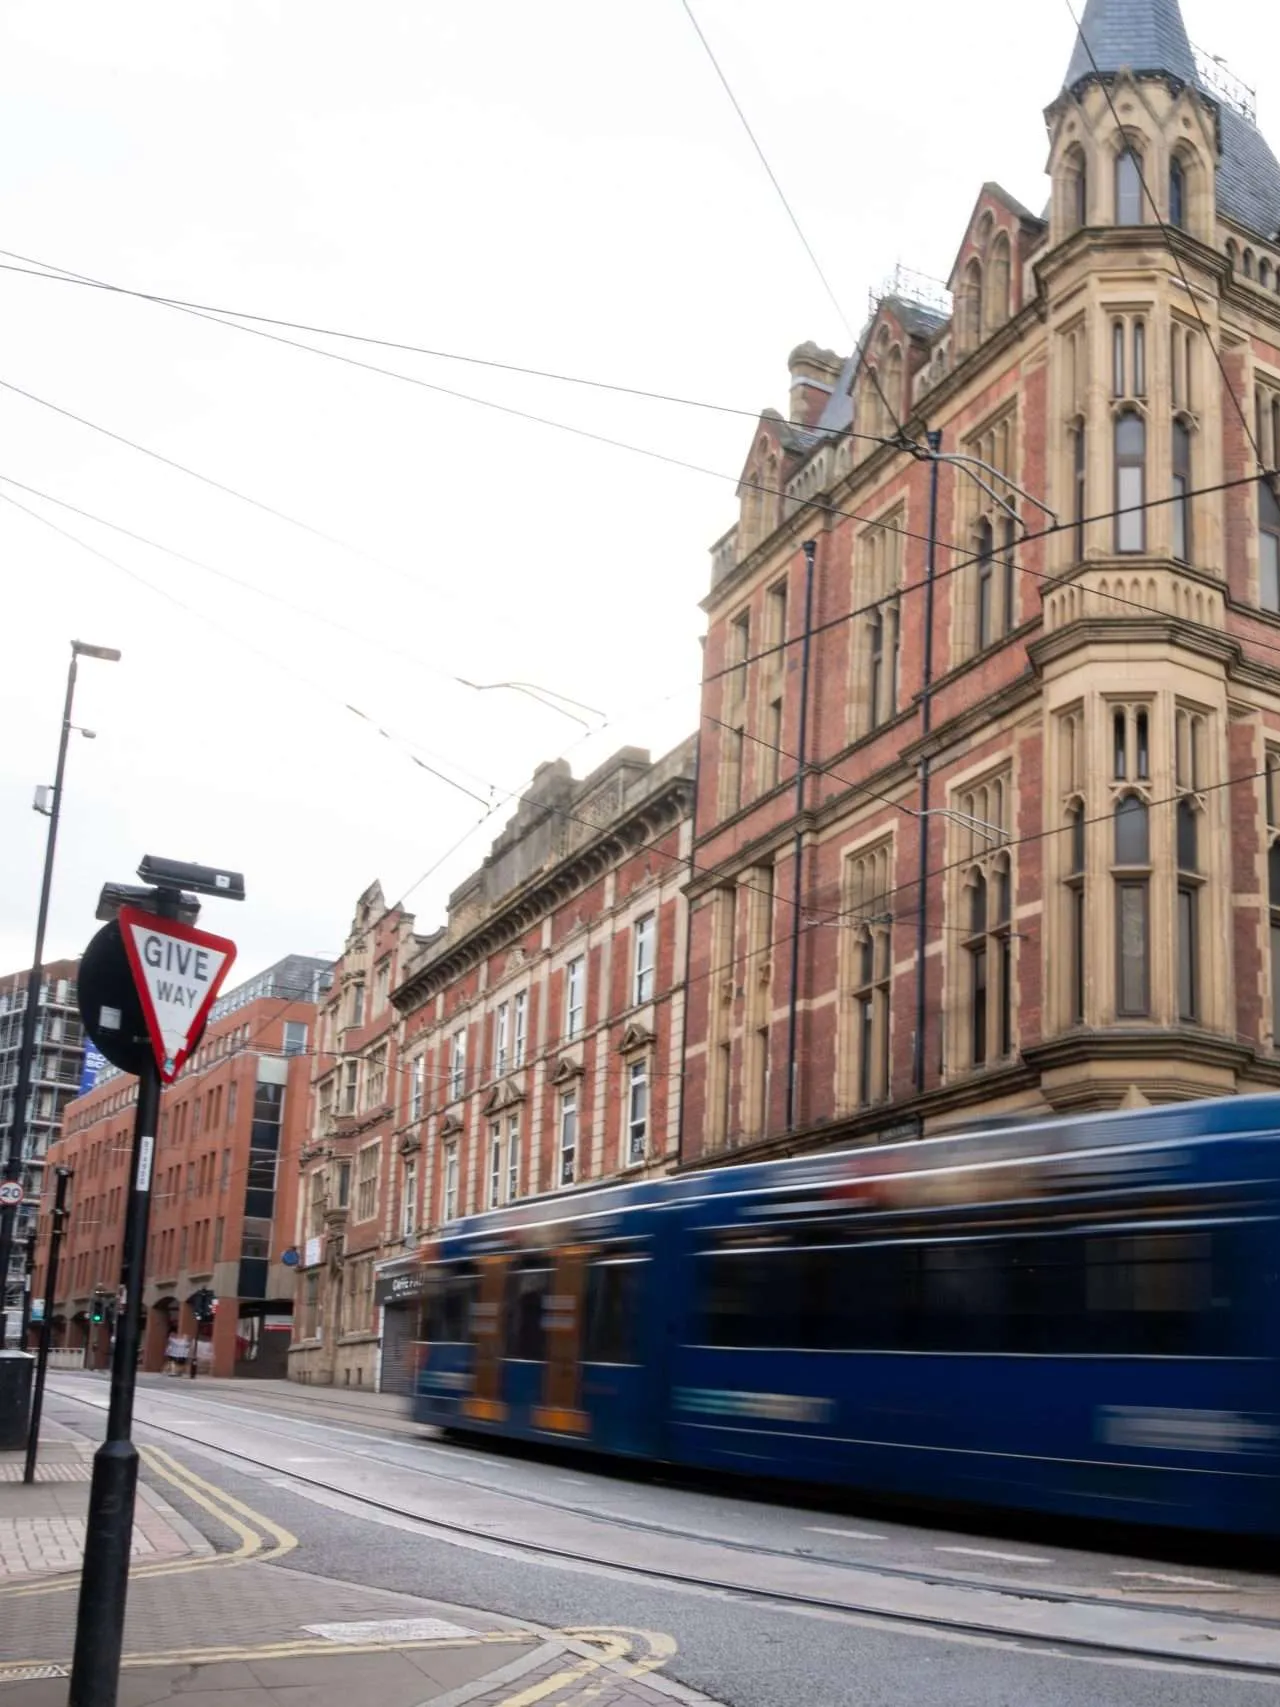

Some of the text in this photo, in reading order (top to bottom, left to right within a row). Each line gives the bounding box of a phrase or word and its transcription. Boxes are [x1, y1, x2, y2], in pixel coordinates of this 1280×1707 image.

[144, 935, 209, 982] GIVE
[157, 979, 198, 1009] WAY
[2, 1187, 20, 1199] 20
